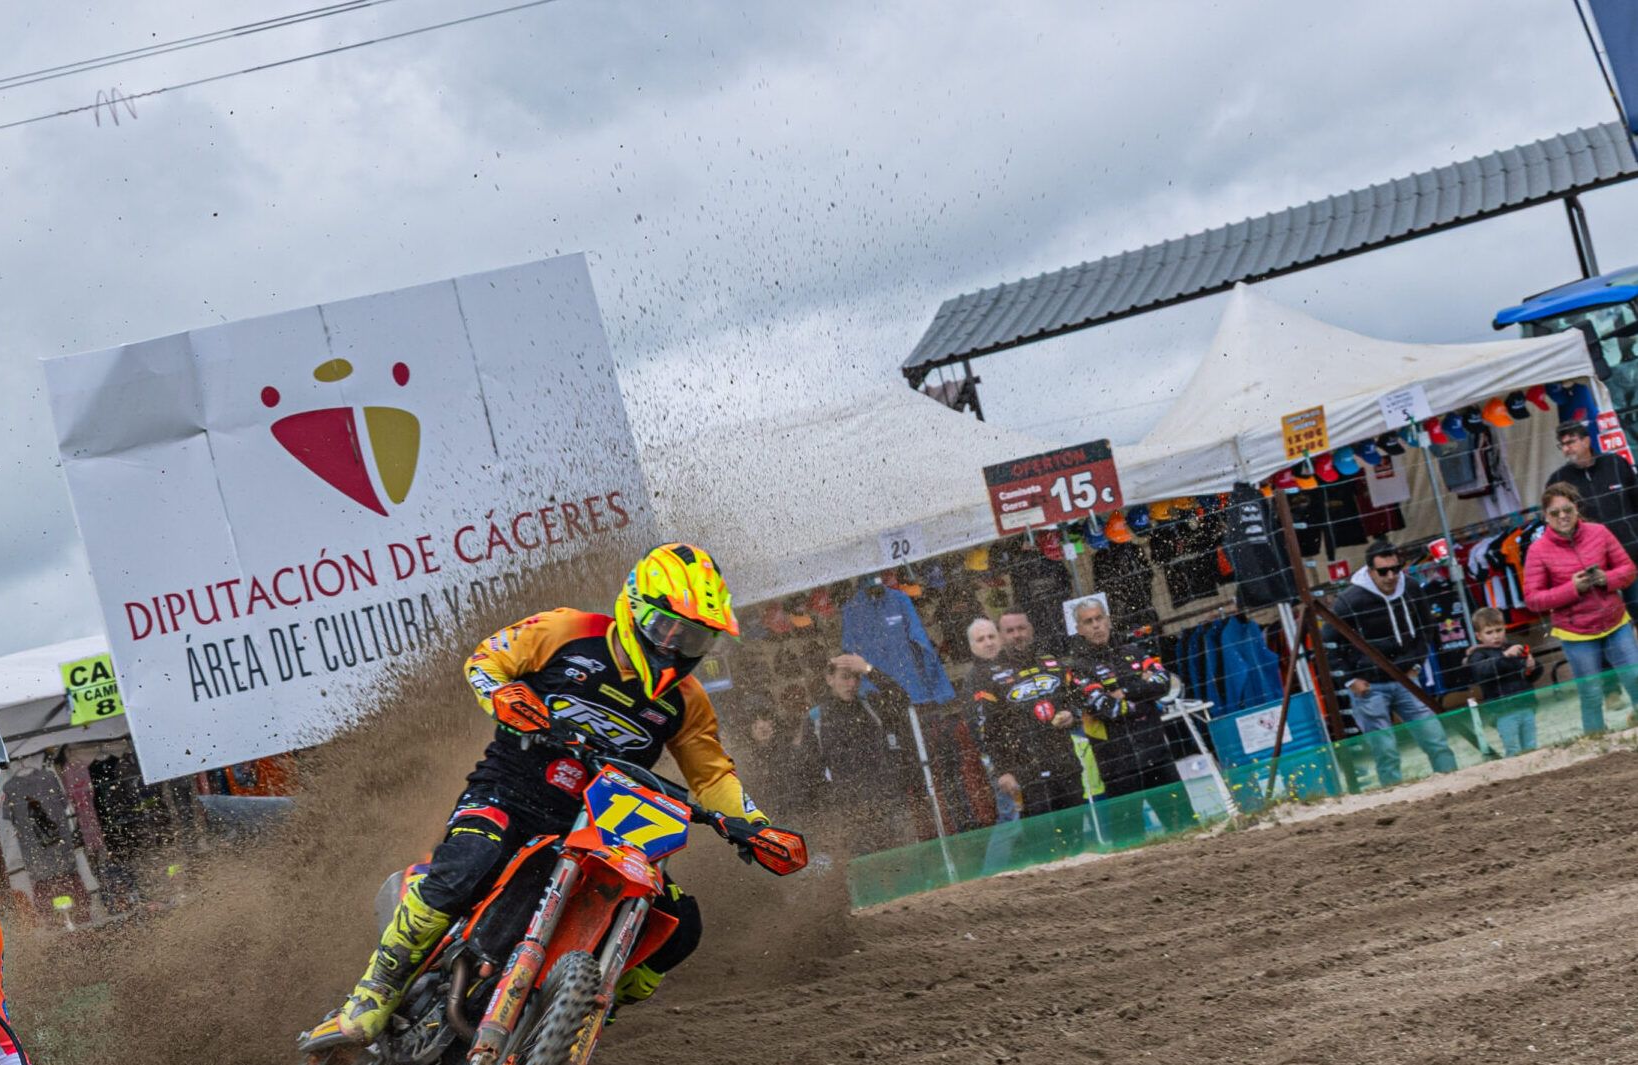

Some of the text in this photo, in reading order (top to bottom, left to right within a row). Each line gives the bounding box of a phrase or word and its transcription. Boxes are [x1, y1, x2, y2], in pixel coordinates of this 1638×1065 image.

[1001, 500, 1029, 512] Gorra
[891, 539, 910, 559] 20
[124, 491, 631, 641] DIPUTACIÓN DE CÁCERES
[185, 634, 268, 702] ÁREA
[270, 624, 307, 682] DE
[315, 592, 450, 671] CULTURA
[70, 661, 115, 687] CA
[96, 699, 116, 716] 8
[594, 793, 687, 850] 17
